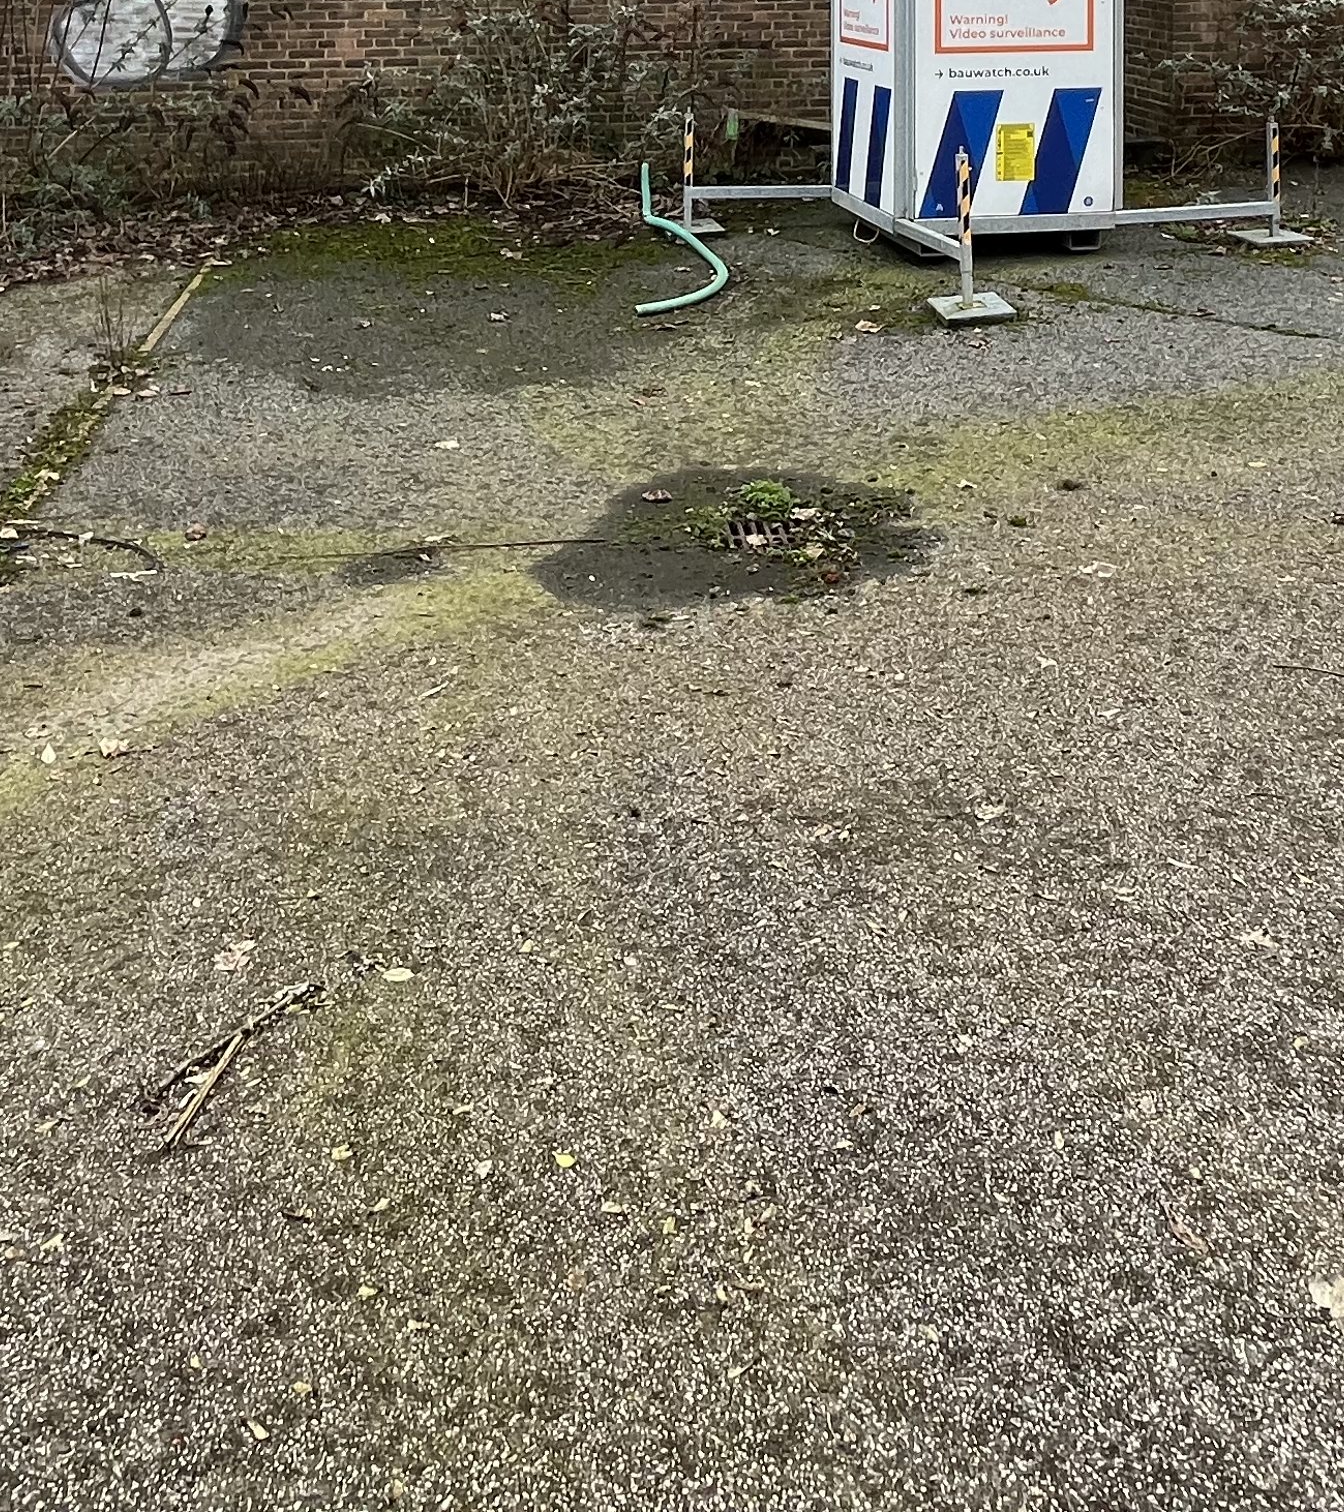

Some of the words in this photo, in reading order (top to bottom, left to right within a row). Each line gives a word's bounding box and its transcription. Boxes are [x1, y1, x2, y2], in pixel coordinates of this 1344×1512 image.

[949, 13, 1009, 27] Warning!
[948, 28, 987, 39] Video
[989, 26, 1066, 39] surveillance
[948, 66, 1050, 79] bauwatch.co.uk
